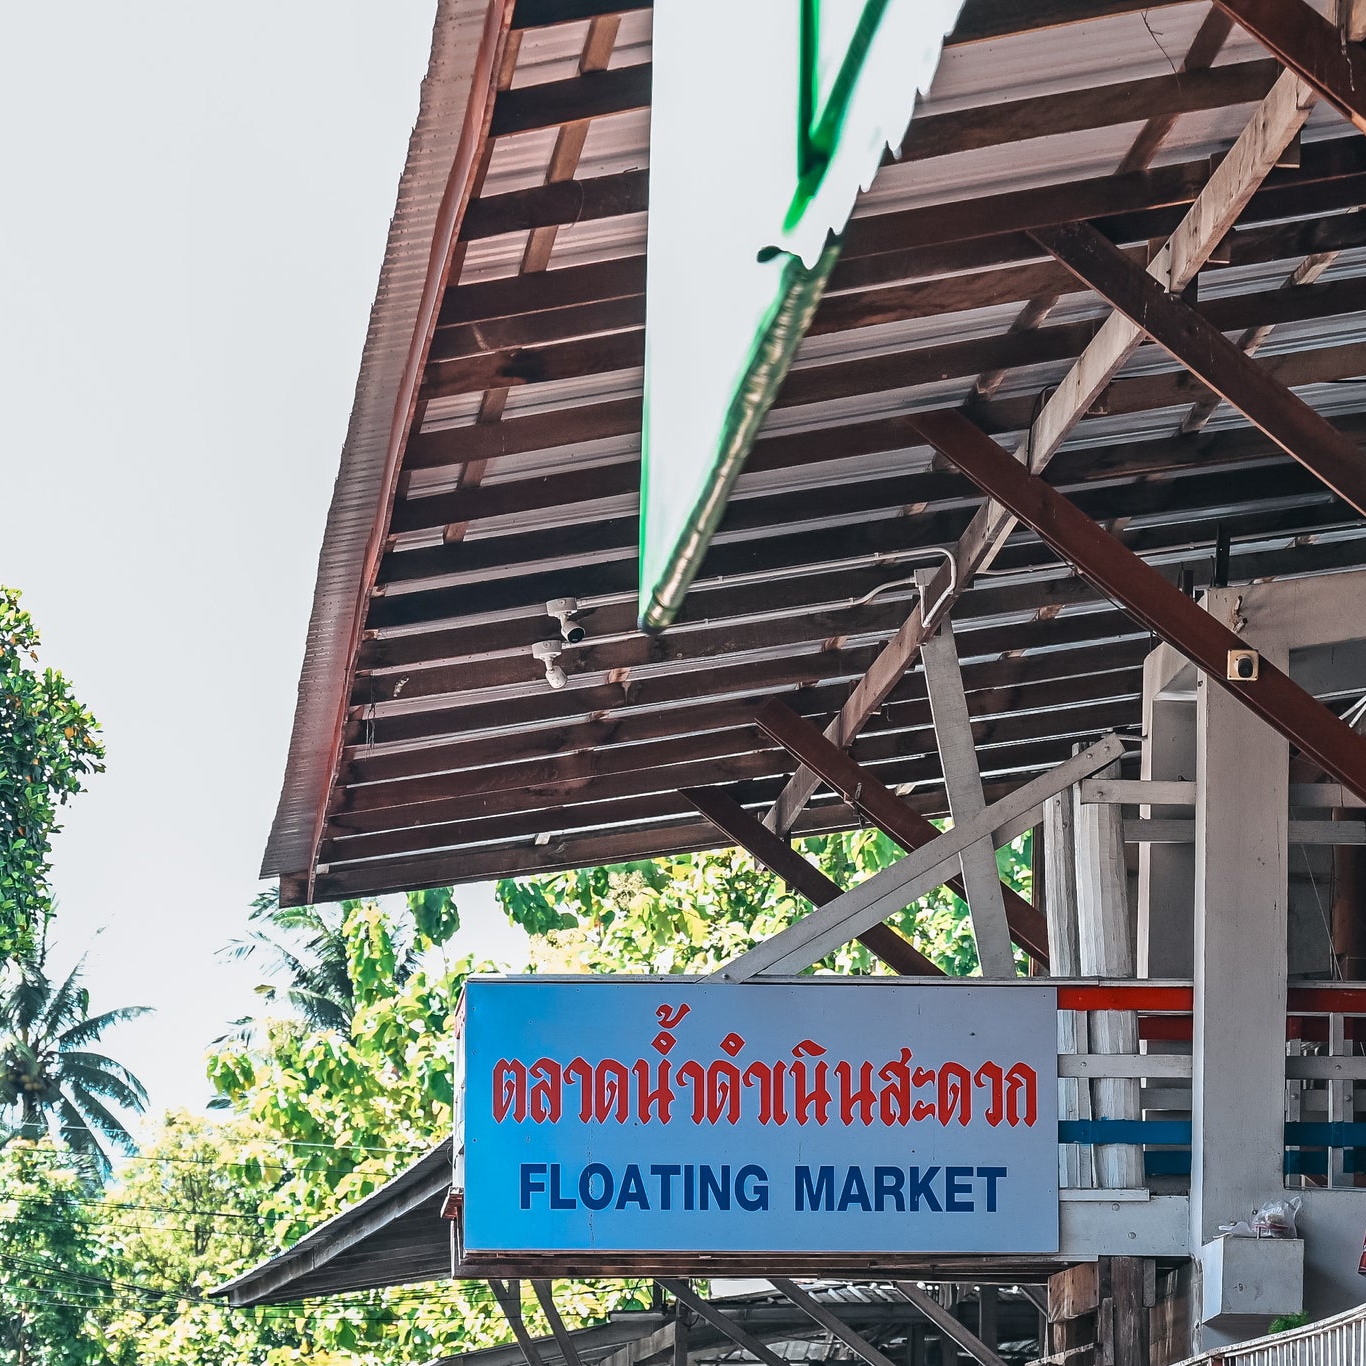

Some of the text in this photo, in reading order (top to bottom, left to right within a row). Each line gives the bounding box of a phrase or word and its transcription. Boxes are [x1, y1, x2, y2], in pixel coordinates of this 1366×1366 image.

[491, 1002, 1039, 1129] ตลาดน้ำดำเนินสะดวก
[518, 1162, 1009, 1213] FLOATING MARKET
